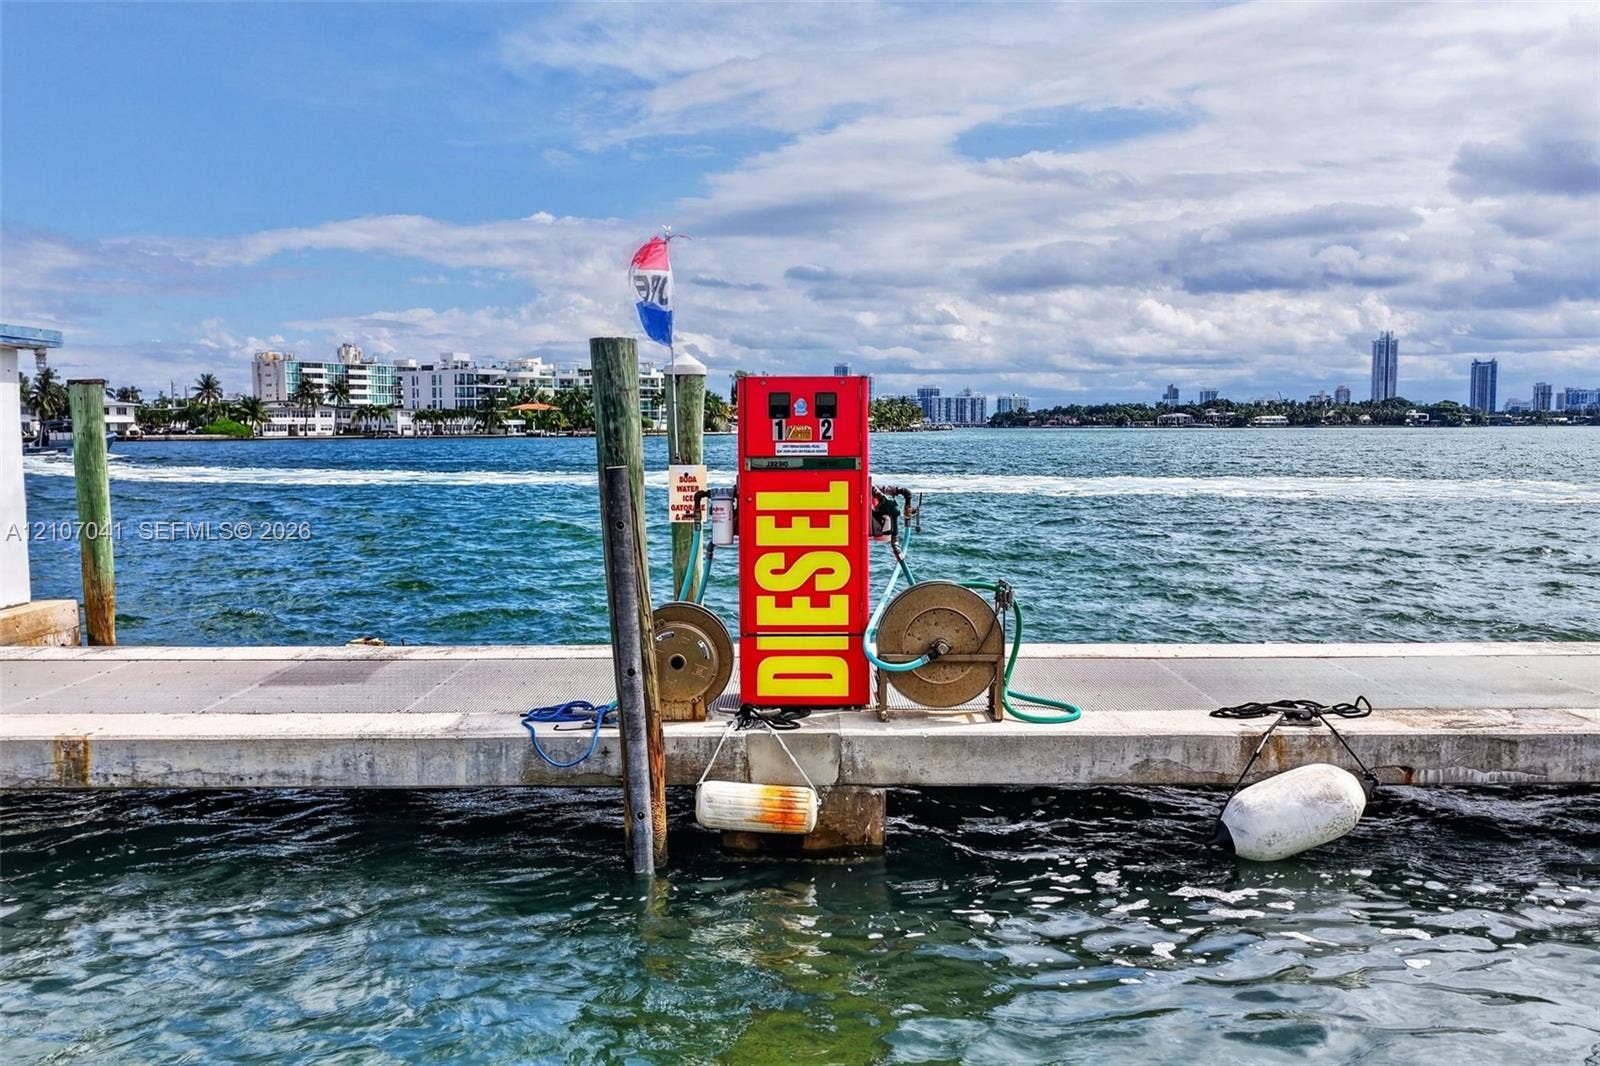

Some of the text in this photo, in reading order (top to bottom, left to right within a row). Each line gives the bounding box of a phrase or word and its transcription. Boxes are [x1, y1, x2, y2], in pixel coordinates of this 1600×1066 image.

[775, 419, 783, 440] 1
[820, 419, 832, 440] 2
[670, 504, 706, 512] GATORE
[682, 494, 693, 502] ICE
[754, 480, 851, 697] DIESEL
